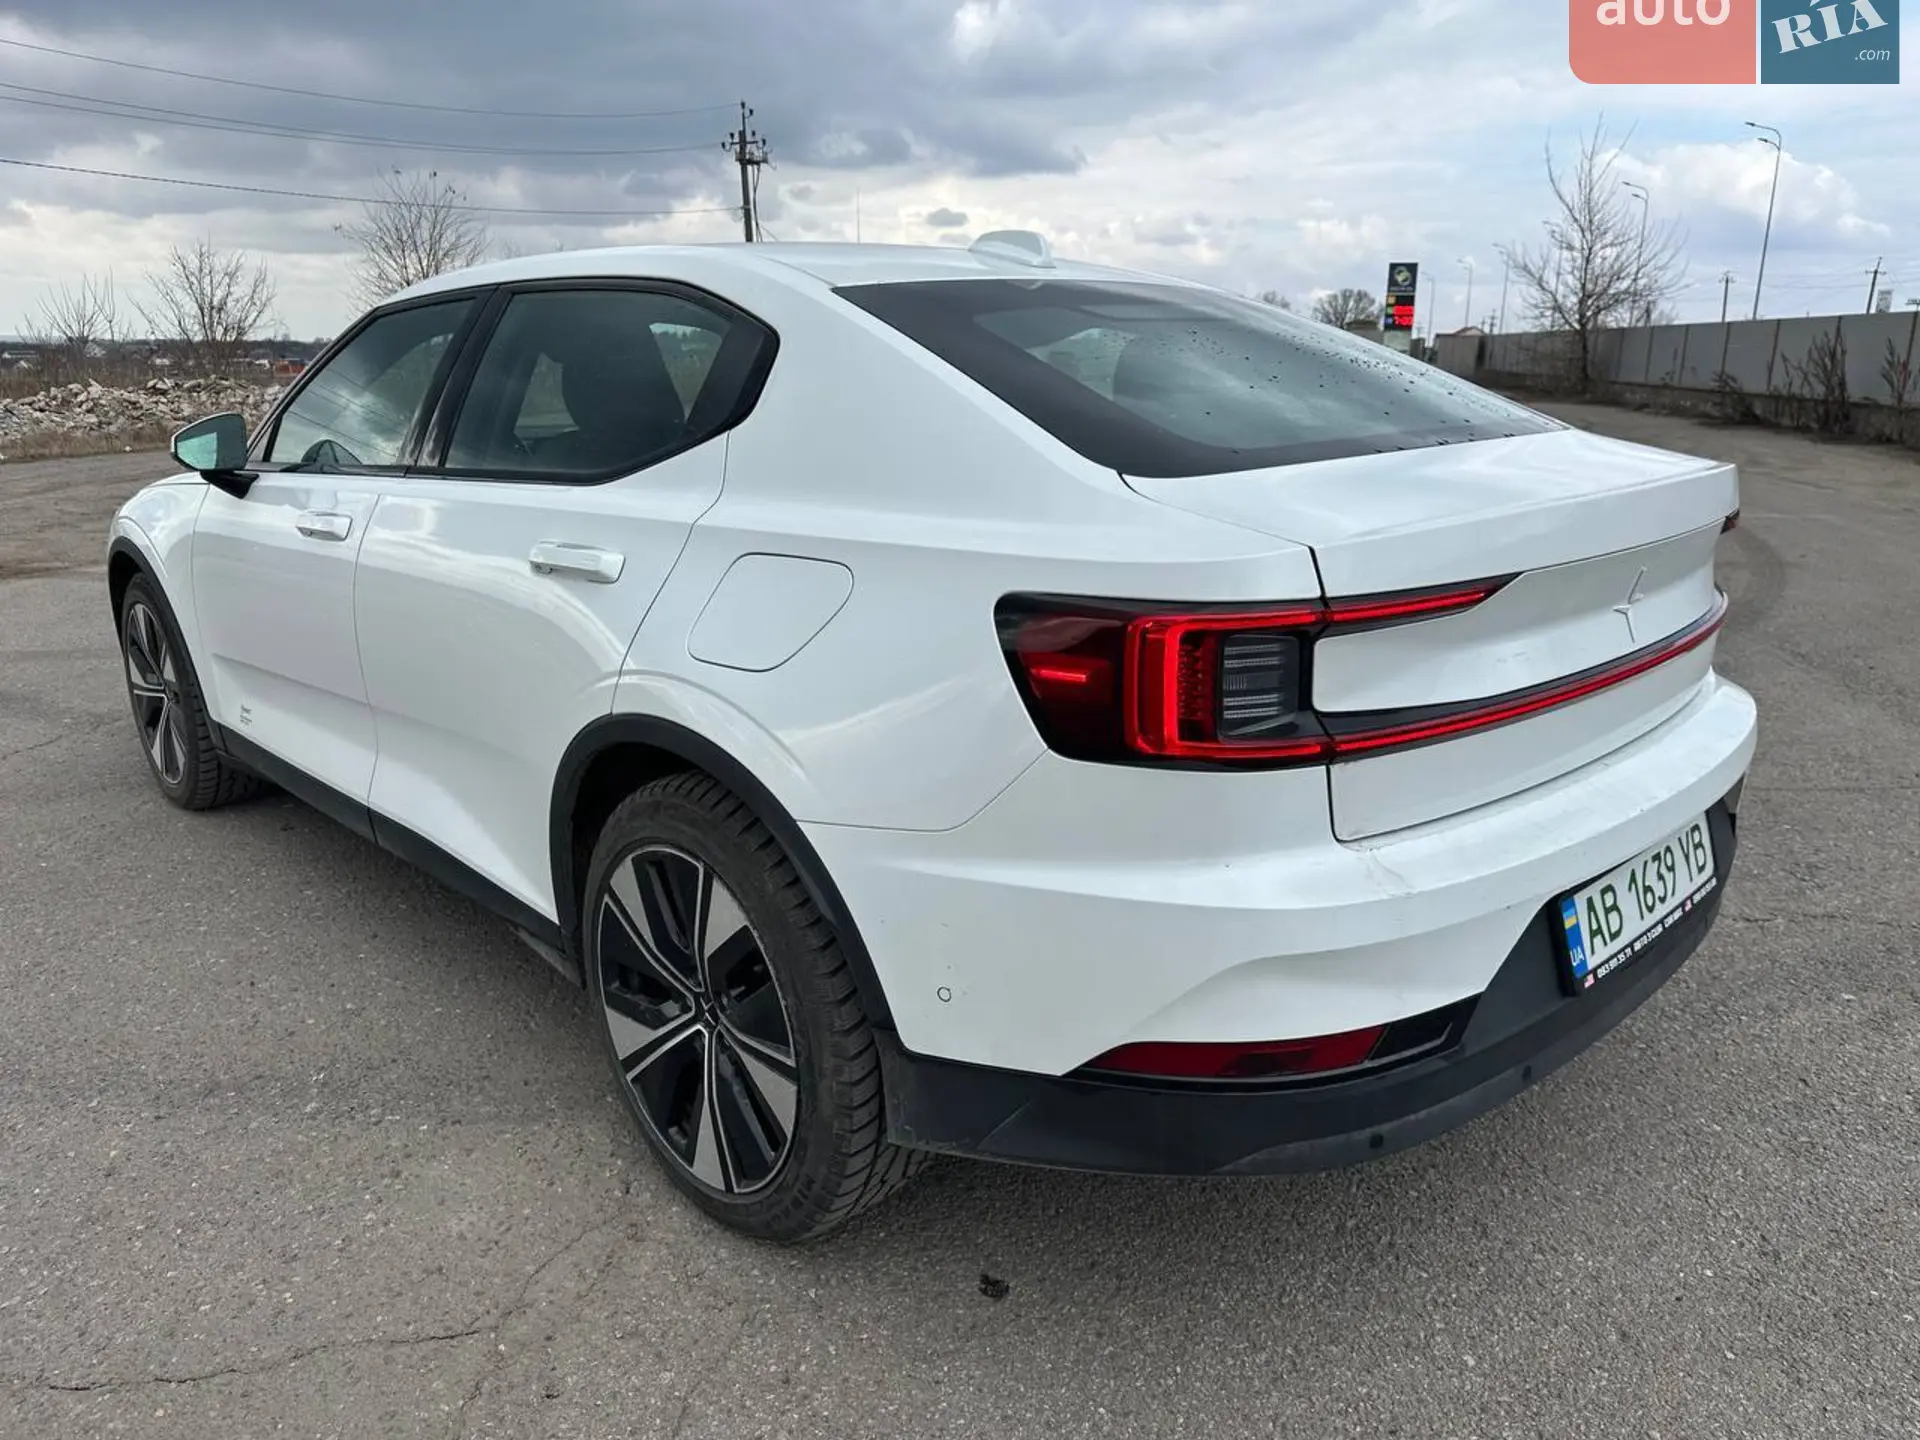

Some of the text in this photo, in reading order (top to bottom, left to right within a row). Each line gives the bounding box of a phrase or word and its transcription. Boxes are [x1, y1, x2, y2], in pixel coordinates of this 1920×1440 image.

[1586, 823, 1707, 956] AB 1639 YB
[1570, 947, 1584, 966] UA
